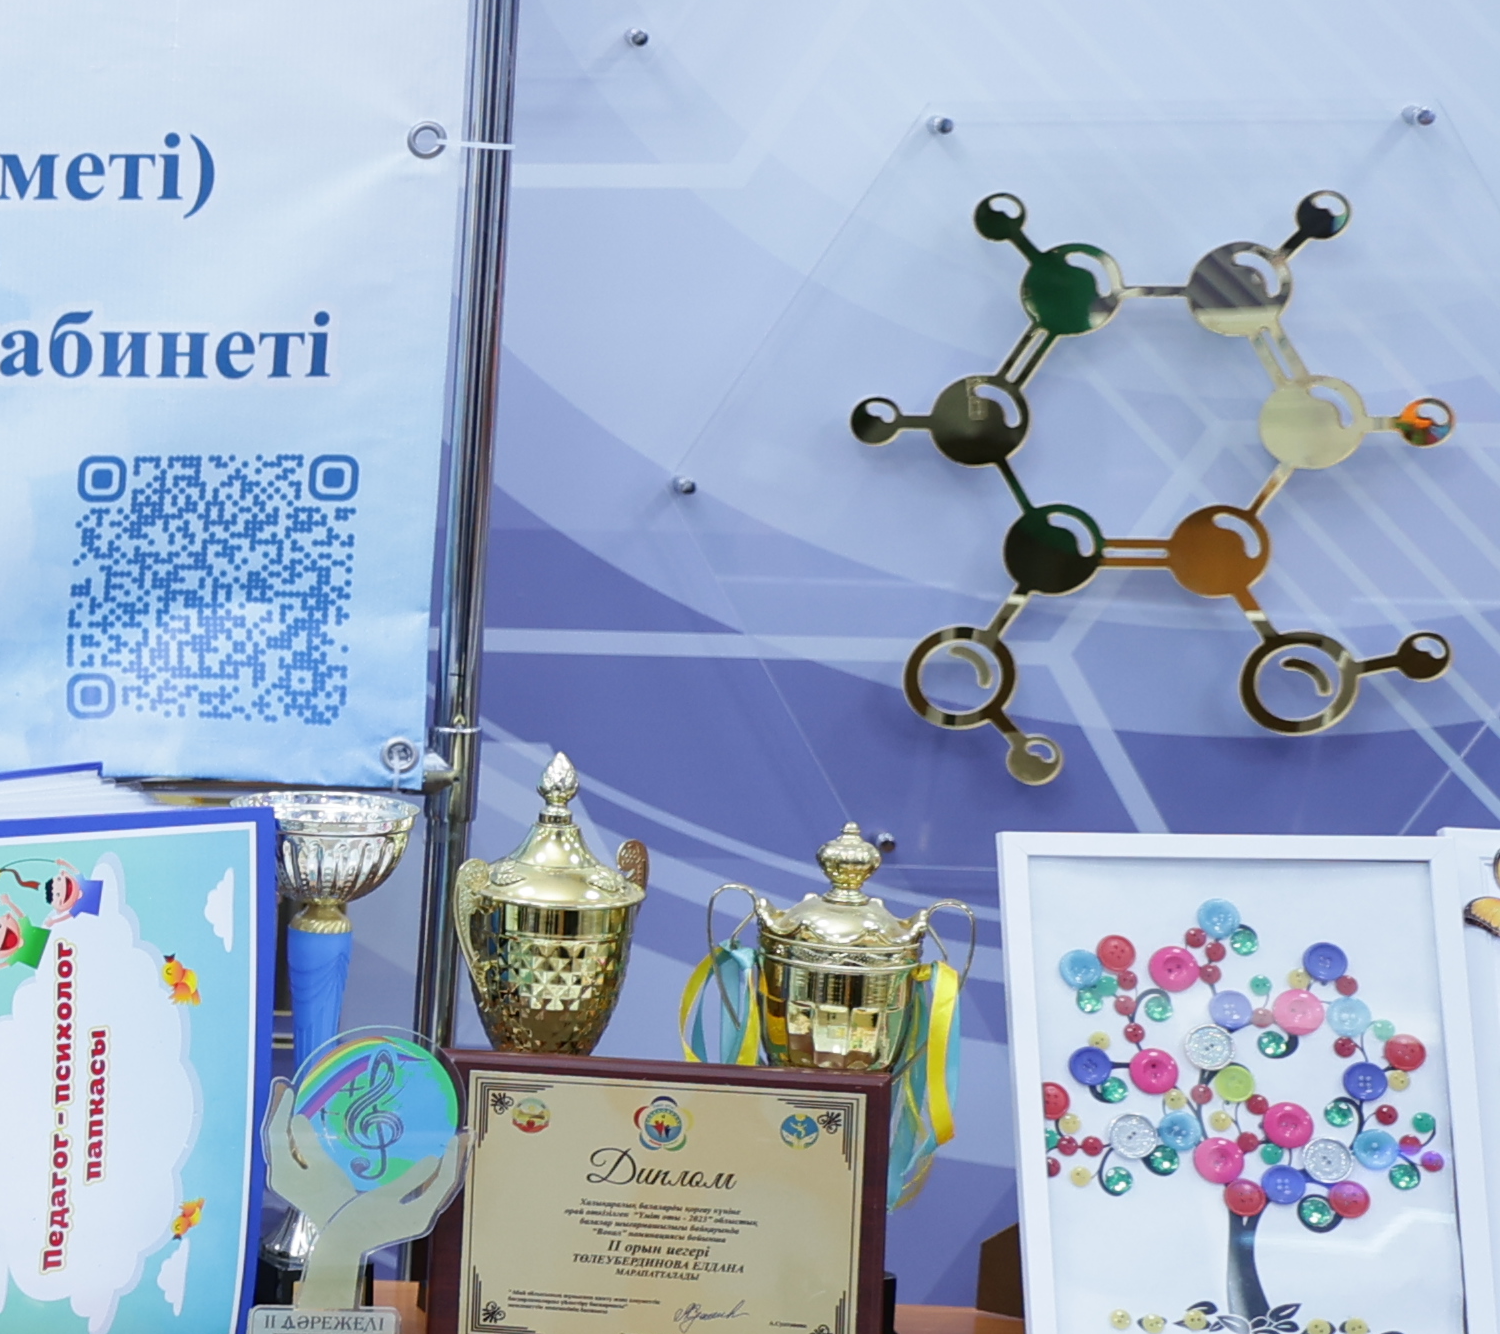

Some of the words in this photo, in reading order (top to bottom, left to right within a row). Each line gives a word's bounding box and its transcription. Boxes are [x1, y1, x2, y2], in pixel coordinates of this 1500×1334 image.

[52, 941, 76, 1107] психолог
[84, 1026, 107, 1183] папкасы
[586, 1146, 737, 1190] Диплом
[40, 1133, 71, 1273] Педагог
[572, 1252, 690, 1271] ТӨЛЕУБЕРДИНОВА
[691, 1261, 745, 1275] ЕЛДАНА
[624, 1243, 659, 1257] орын
[666, 1244, 711, 1259] иегері
[614, 1268, 701, 1281] МАРАПАТТАЛАДЫ
[281, 1314, 384, 1333] ДӘРЕЖЕЛІ
